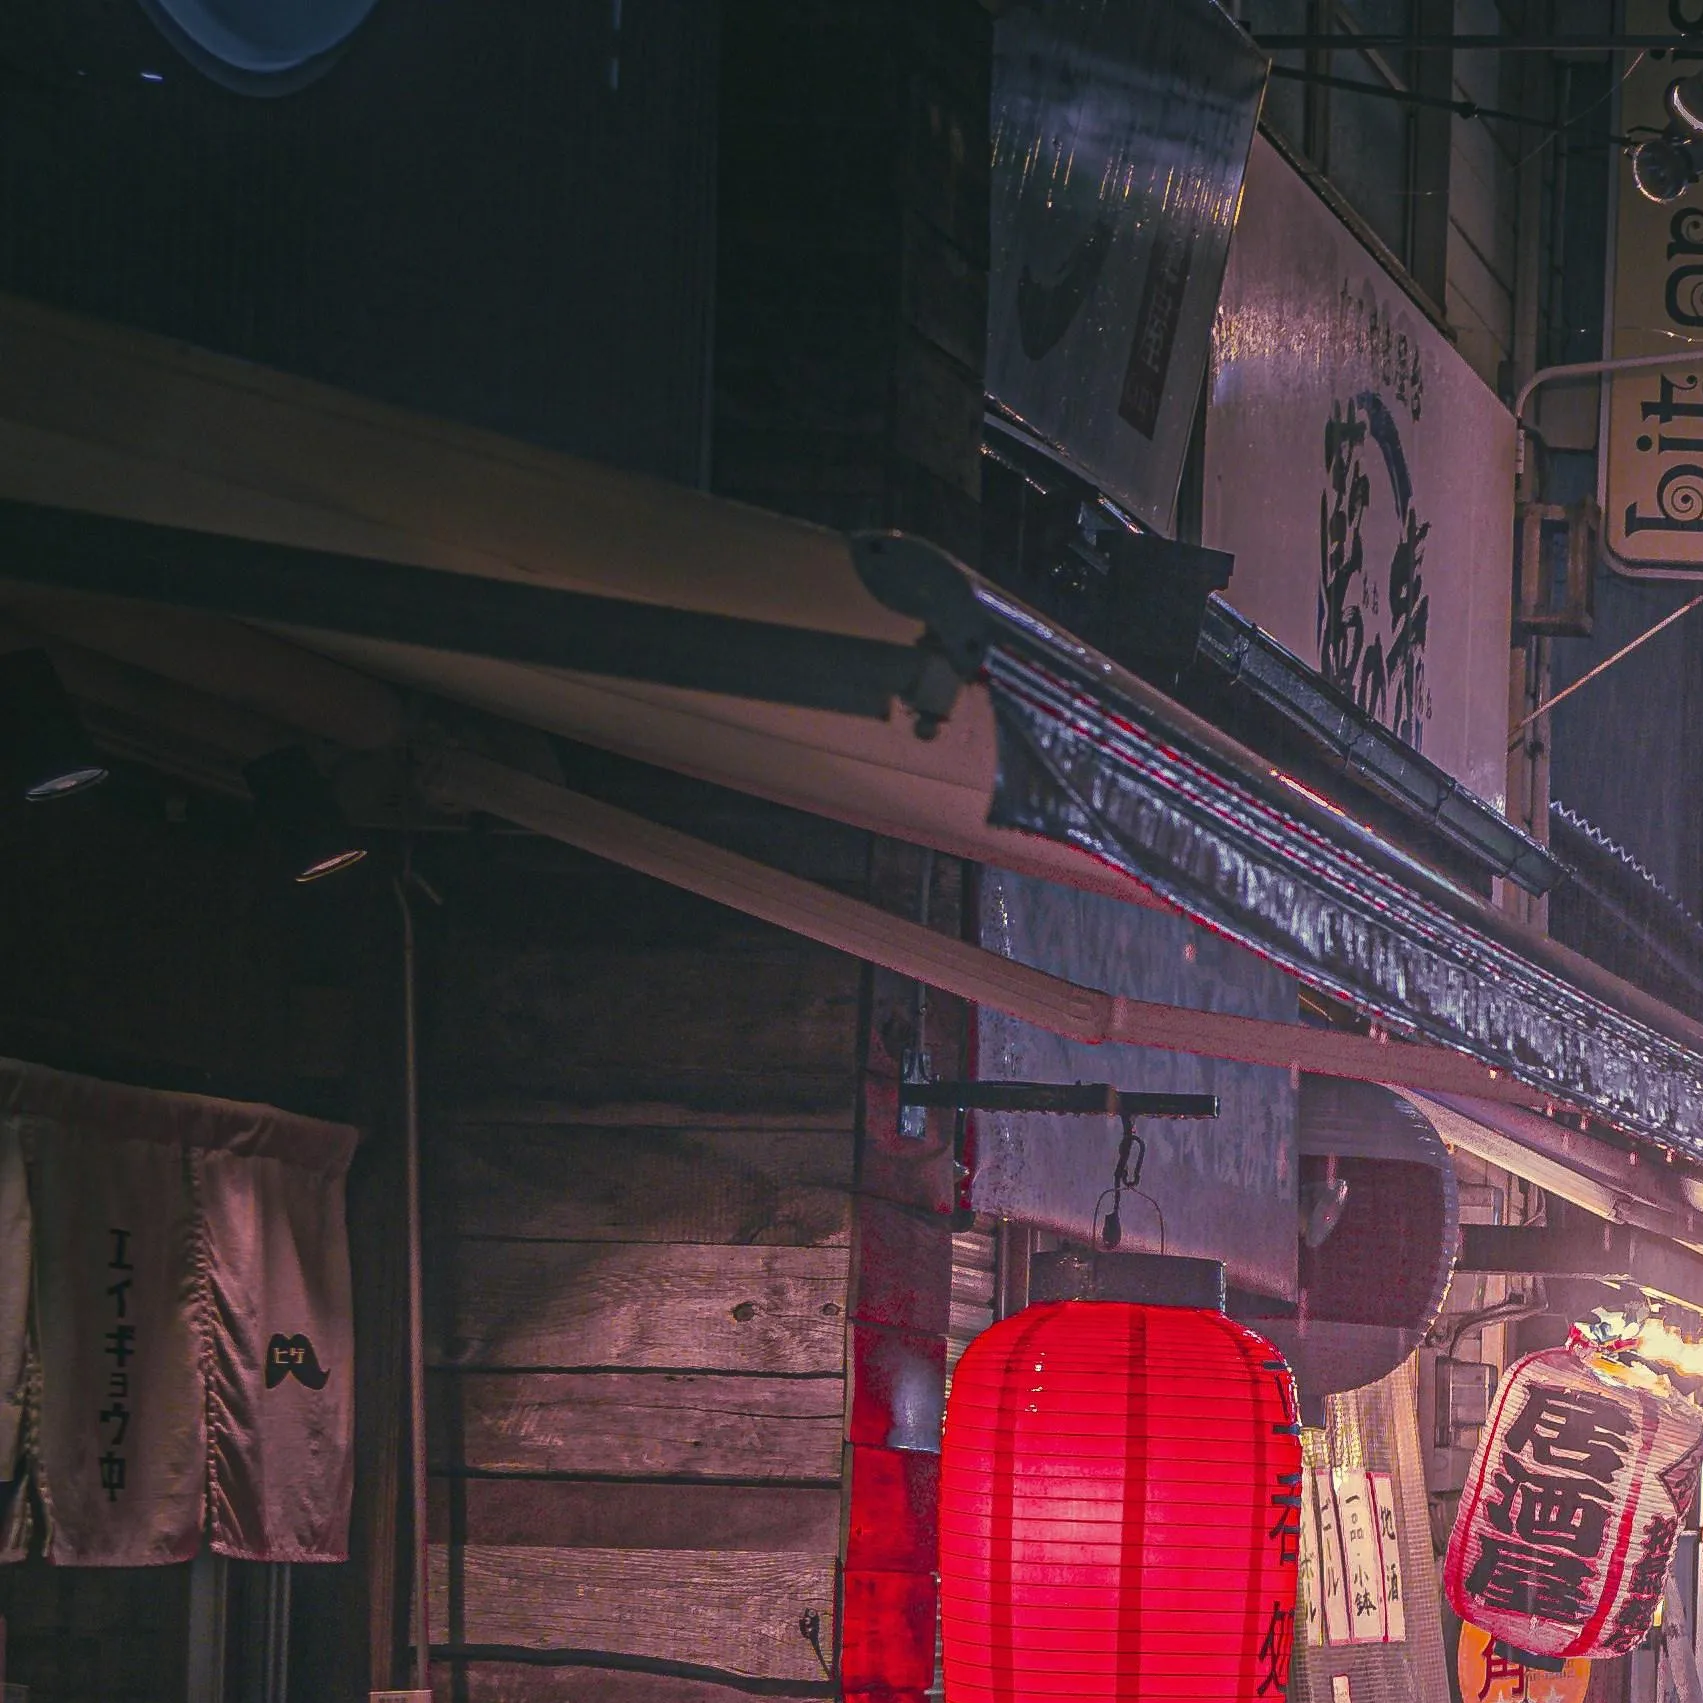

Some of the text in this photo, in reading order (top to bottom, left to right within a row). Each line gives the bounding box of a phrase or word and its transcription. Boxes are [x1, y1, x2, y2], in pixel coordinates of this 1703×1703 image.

[98, 1228, 135, 1502] エイギョウ中
[273, 1346, 306, 1364] ヒゲ
[1467, 1384, 1639, 1624] 居酒屋
